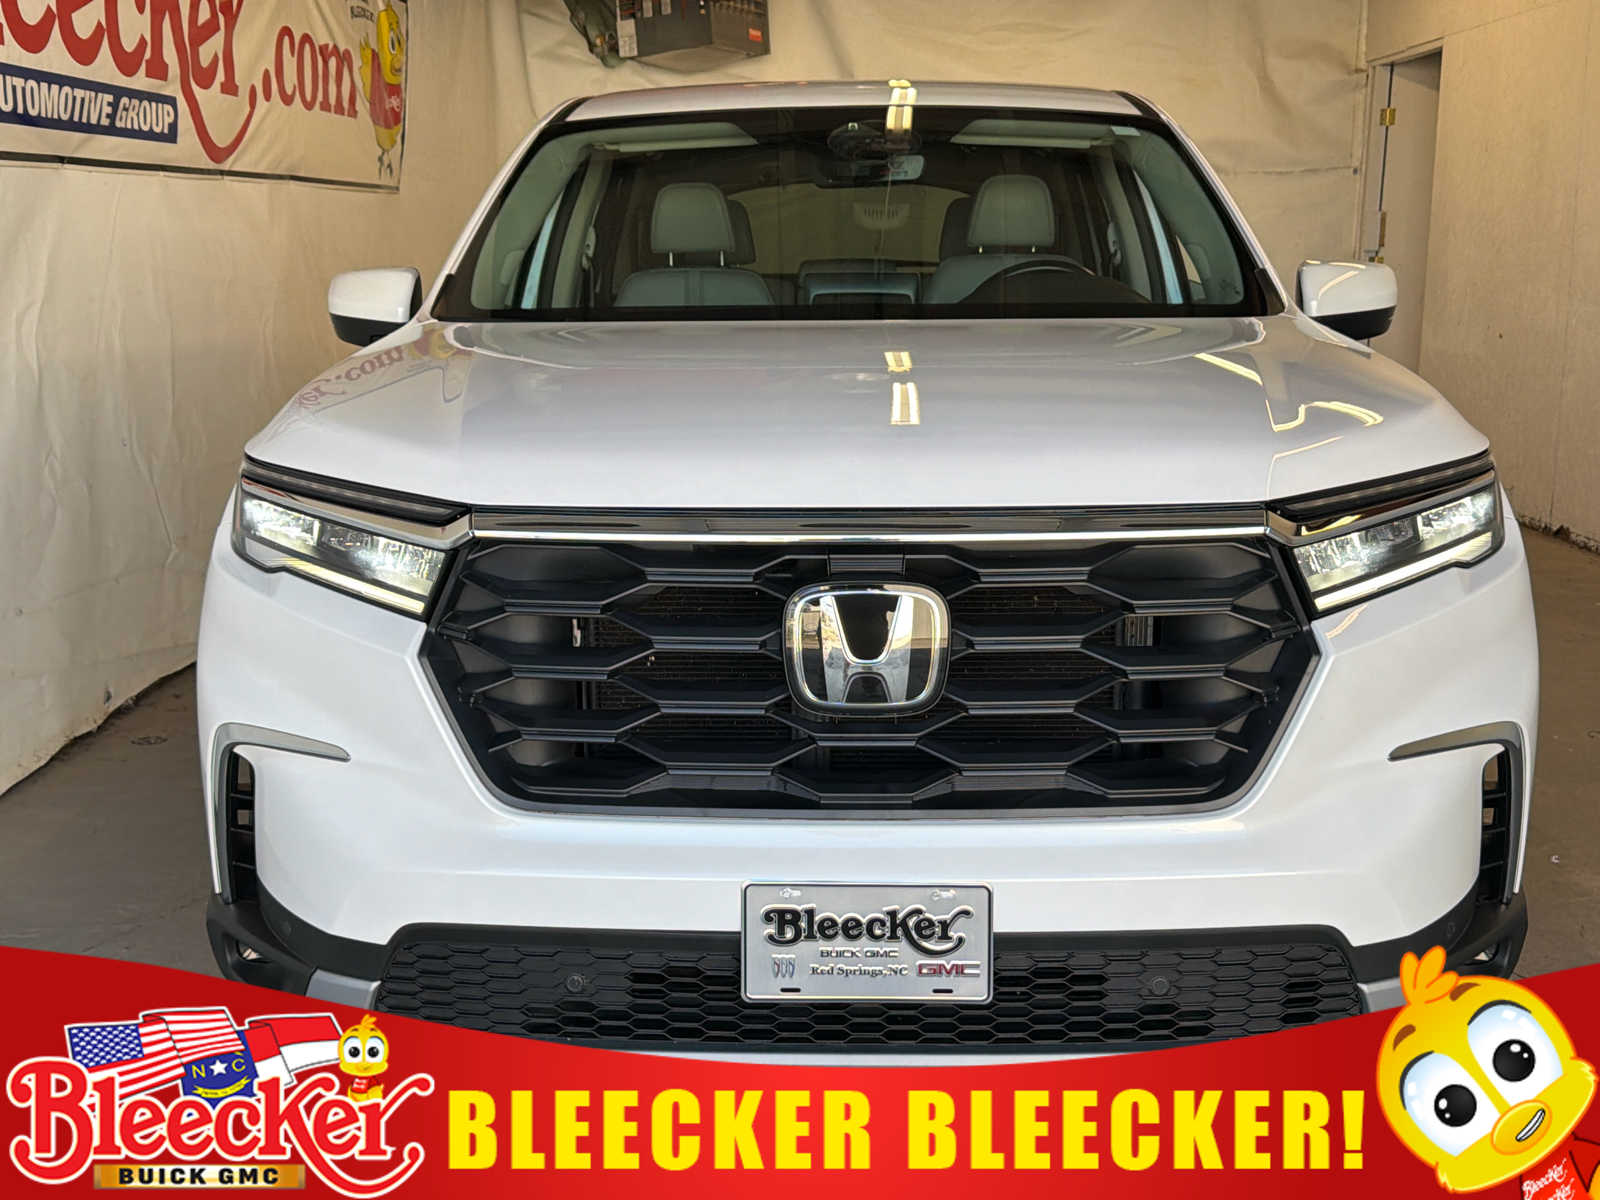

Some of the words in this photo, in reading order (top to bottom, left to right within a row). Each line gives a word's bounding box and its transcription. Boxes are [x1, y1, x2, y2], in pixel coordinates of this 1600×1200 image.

[115, 96, 175, 135] GROUP
[761, 904, 974, 959] Bleecker
[819, 948, 861, 959] BUICK
[864, 948, 900, 959] GMC
[810, 964, 834, 976] Red
[916, 961, 981, 978] GMC
